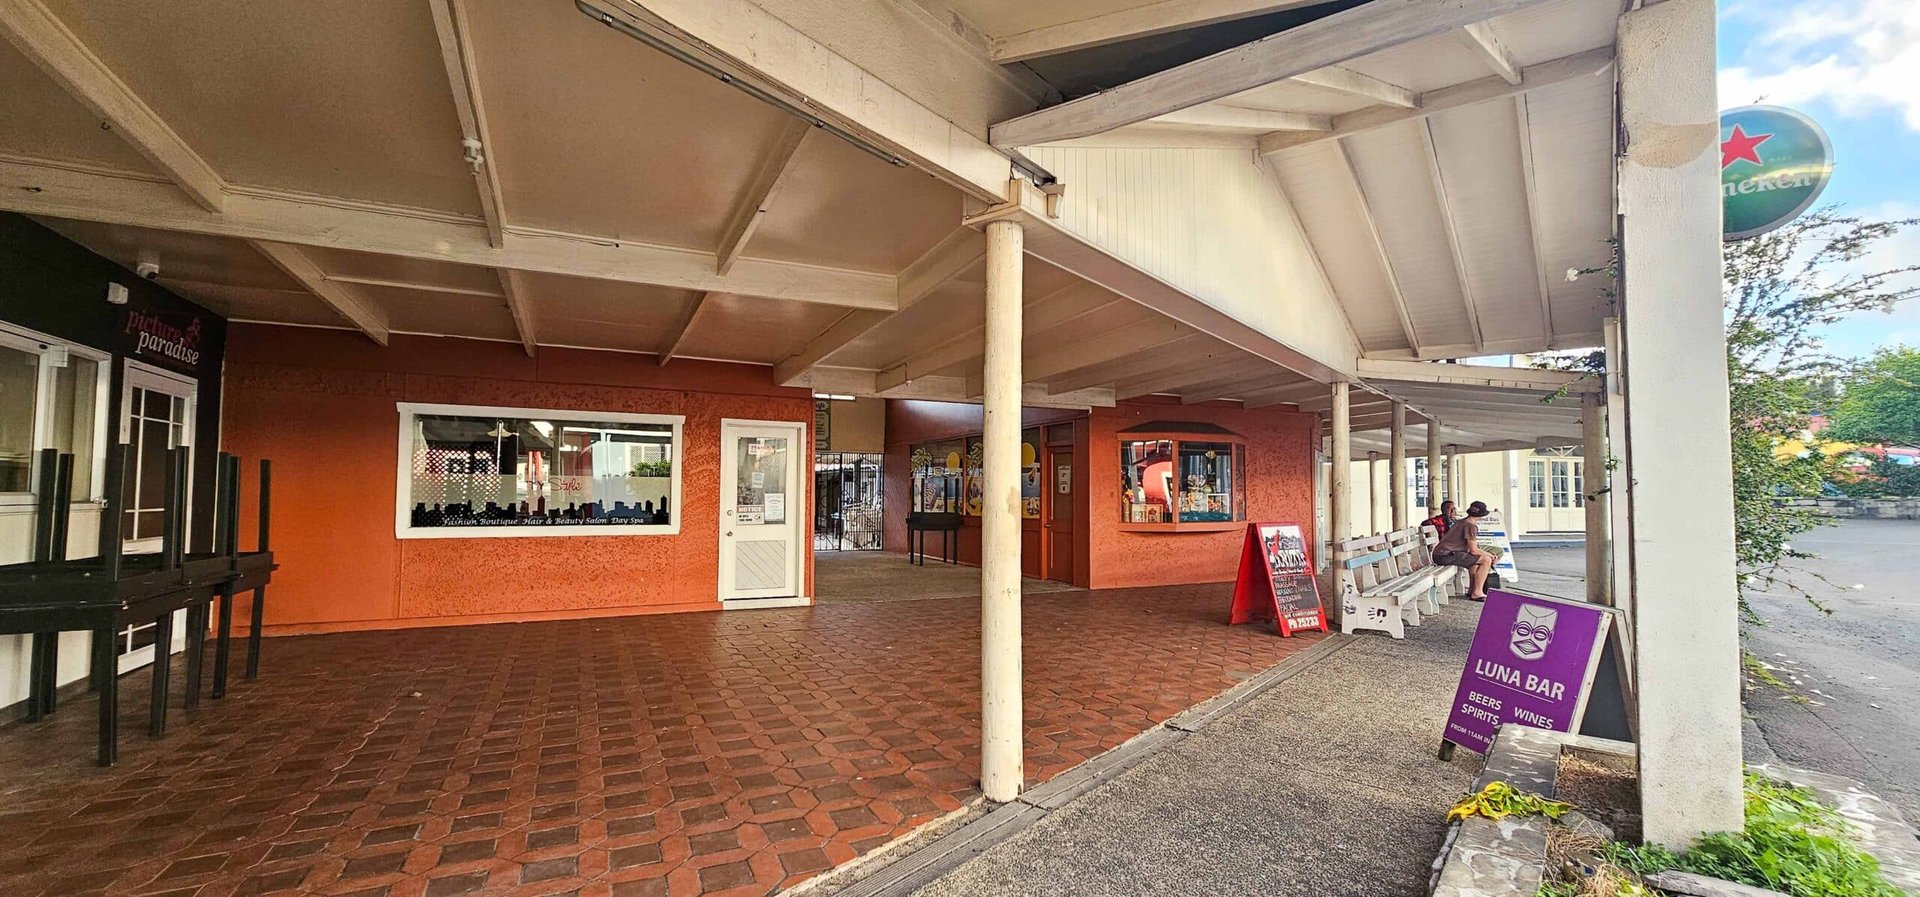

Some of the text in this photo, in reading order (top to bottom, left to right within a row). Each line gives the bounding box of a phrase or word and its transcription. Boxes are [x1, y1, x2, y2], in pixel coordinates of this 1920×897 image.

[1722, 173, 1812, 198] neken
[125, 310, 181, 342] picture
[134, 331, 199, 365] paradise
[548, 477, 582, 496] Style
[442, 518, 477, 526] Fashion
[480, 518, 517, 526] Boutique
[586, 517, 607, 525] Salon
[630, 517, 644, 525] Spa
[1288, 619, 1297, 629] Ph
[1475, 659, 1565, 701] LUNA BAR
[1461, 704, 1500, 725] SPIRITS
[1469, 691, 1554, 729] BEERS WINES
[1450, 723, 1467, 733] FROM
[1468, 730, 1483, 741] 11AM
